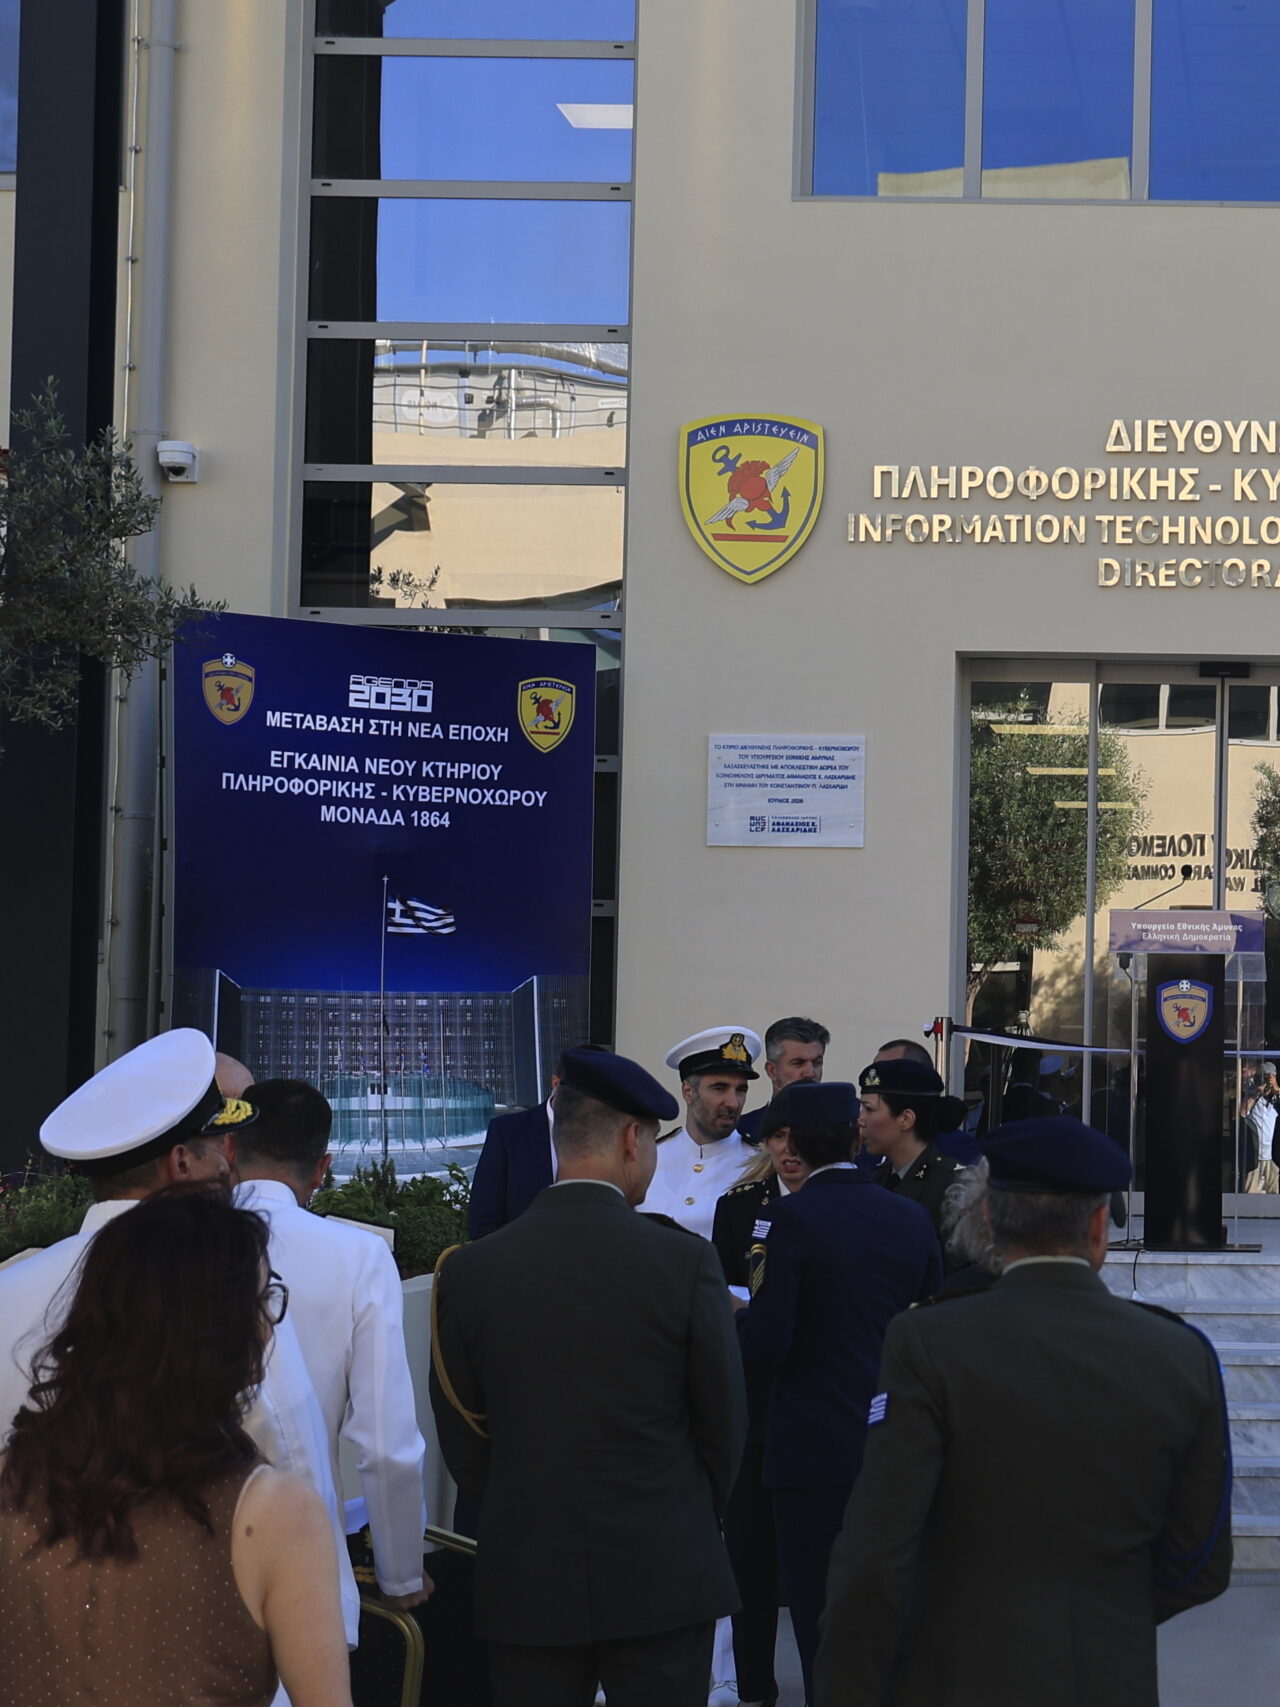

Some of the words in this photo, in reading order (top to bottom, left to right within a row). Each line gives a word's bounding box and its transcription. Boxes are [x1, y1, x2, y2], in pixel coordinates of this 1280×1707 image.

[872, 465, 1200, 500] ΠΛΗΡΟΦΟΡΙΚΗΣ
[847, 513, 1086, 545] INFORMATION
[348, 684, 434, 713] 2030
[266, 710, 364, 734] ΜΕΤΑΒΑΣΗ
[369, 718, 402, 737] ΣΤΗ
[407, 721, 445, 740] ΝΕΑ
[448, 724, 509, 743] ΕΠΟΧΗ
[270, 750, 360, 774] ΕΓΚΑΙΝΙΑ
[365, 757, 417, 777] ΝΕΟΥ
[421, 761, 504, 782] ΚΤΗΡΙΟΥ
[221, 772, 376, 799] ΠΛΗΡΟΦΟΡΙΚΗΣ
[392, 783, 548, 808] ΚΥΒΕΡΝΟΧΩΡΟΥ
[320, 805, 405, 826] ΜΟΝΑΔΑ
[410, 810, 451, 828] 1864
[1130, 921, 1175, 932] Υπουργείο
[1177, 922, 1210, 932] Εθνικής
[1211, 922, 1243, 933] Άμυνας
[1142, 932, 1180, 942] Ελληνική
[1182, 932, 1231, 943] Δημοκρατία
